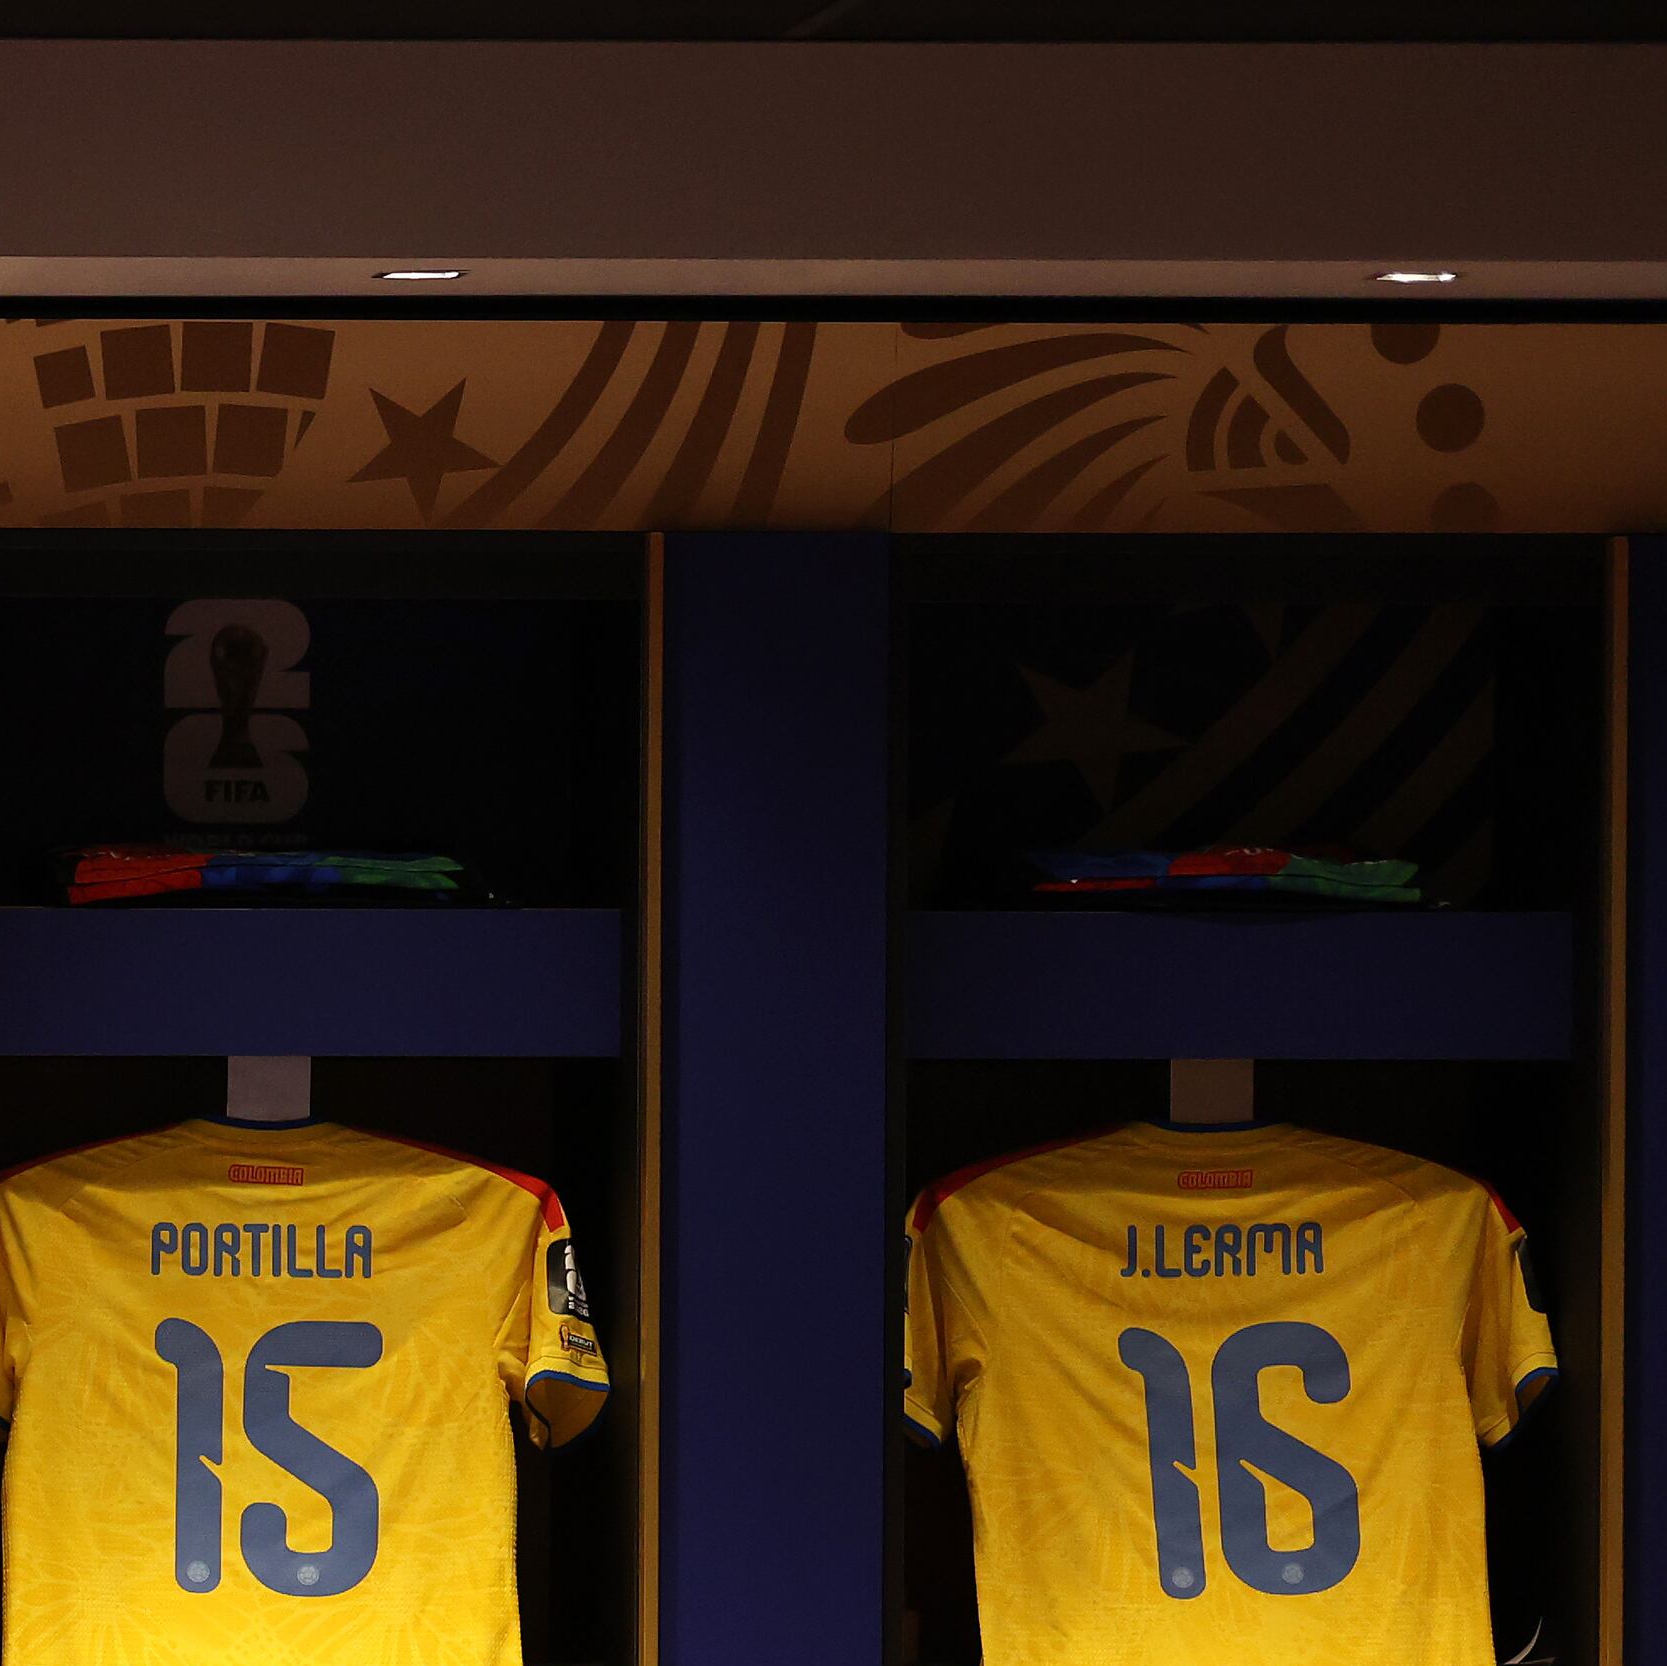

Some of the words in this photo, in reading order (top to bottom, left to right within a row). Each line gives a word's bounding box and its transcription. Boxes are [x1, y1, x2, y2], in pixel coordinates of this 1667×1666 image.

[204, 779, 271, 802] FIFA
[150, 1221, 373, 1280] PORTILLA
[1120, 1221, 1325, 1279] J.LERMA
[155, 1317, 383, 1597] 15
[1118, 1321, 1360, 1600] 16
